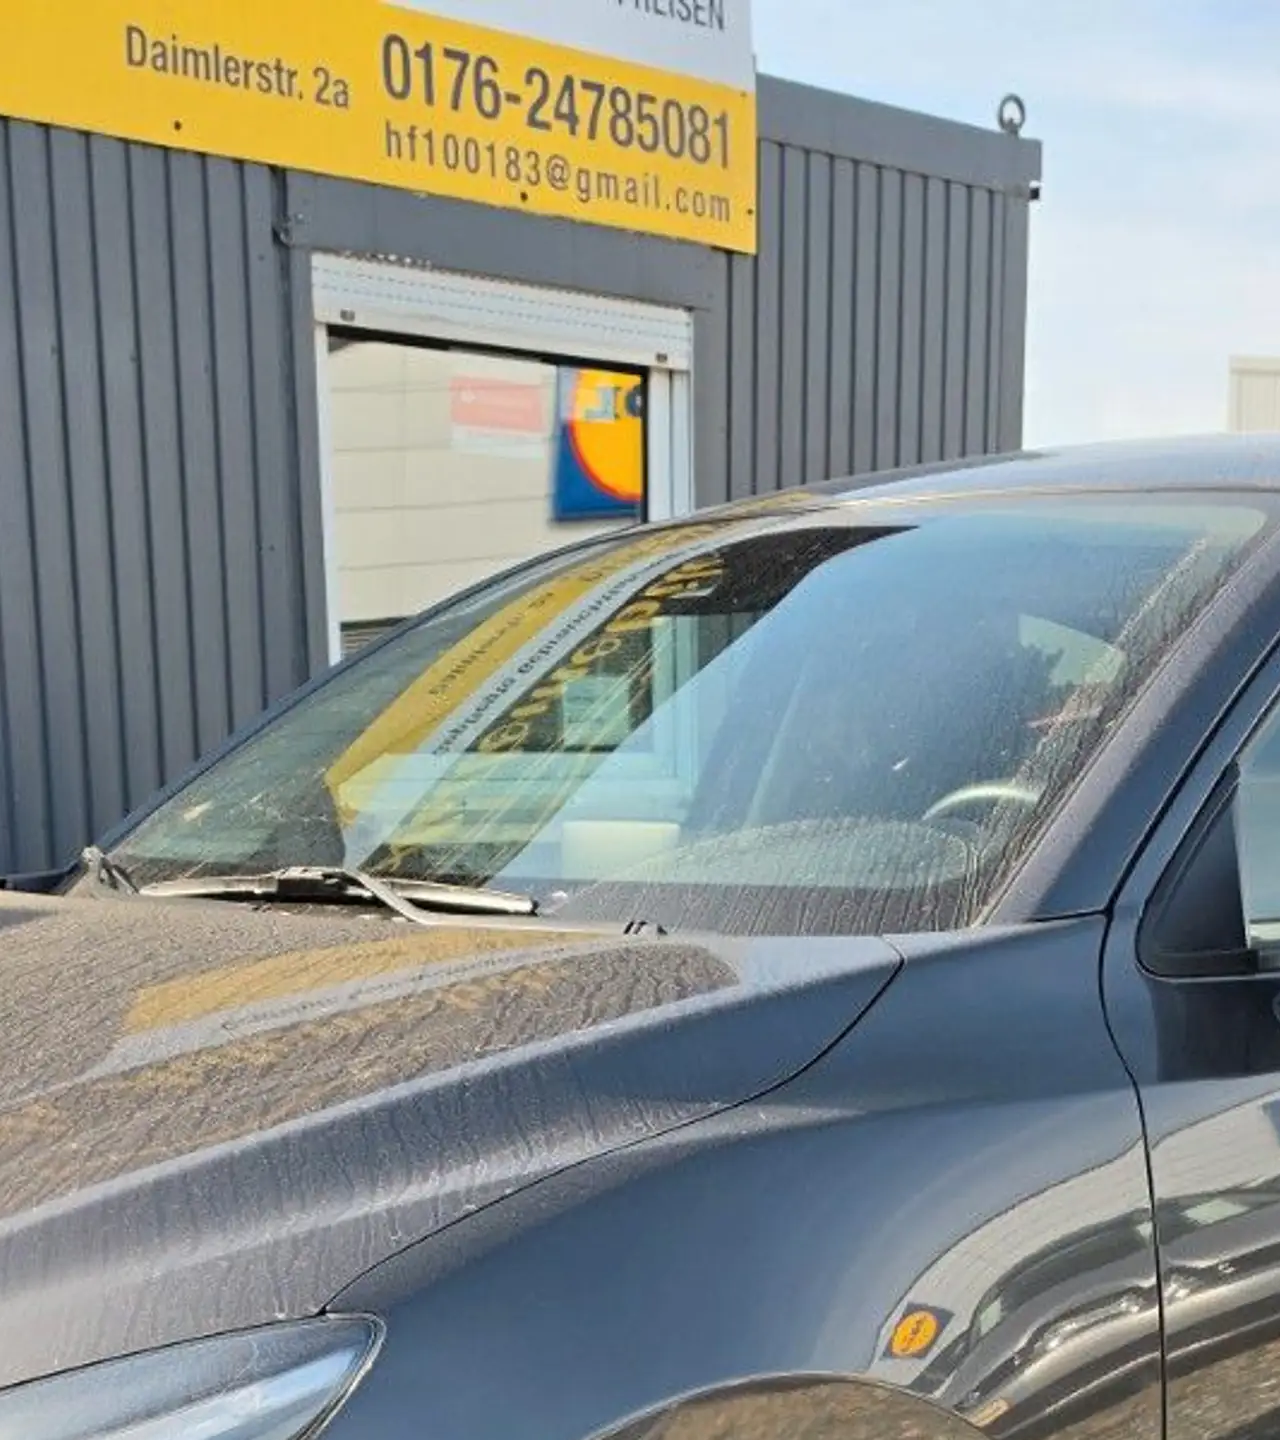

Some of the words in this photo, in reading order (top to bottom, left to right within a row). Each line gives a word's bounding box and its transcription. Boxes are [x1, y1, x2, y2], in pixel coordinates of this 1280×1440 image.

[125, 24, 304, 101] Daimlerstr.
[313, 66, 350, 110] 2a
[382, 33, 729, 169] 0176-24785081
[385, 120, 731, 222] hf100183@gmail.com
